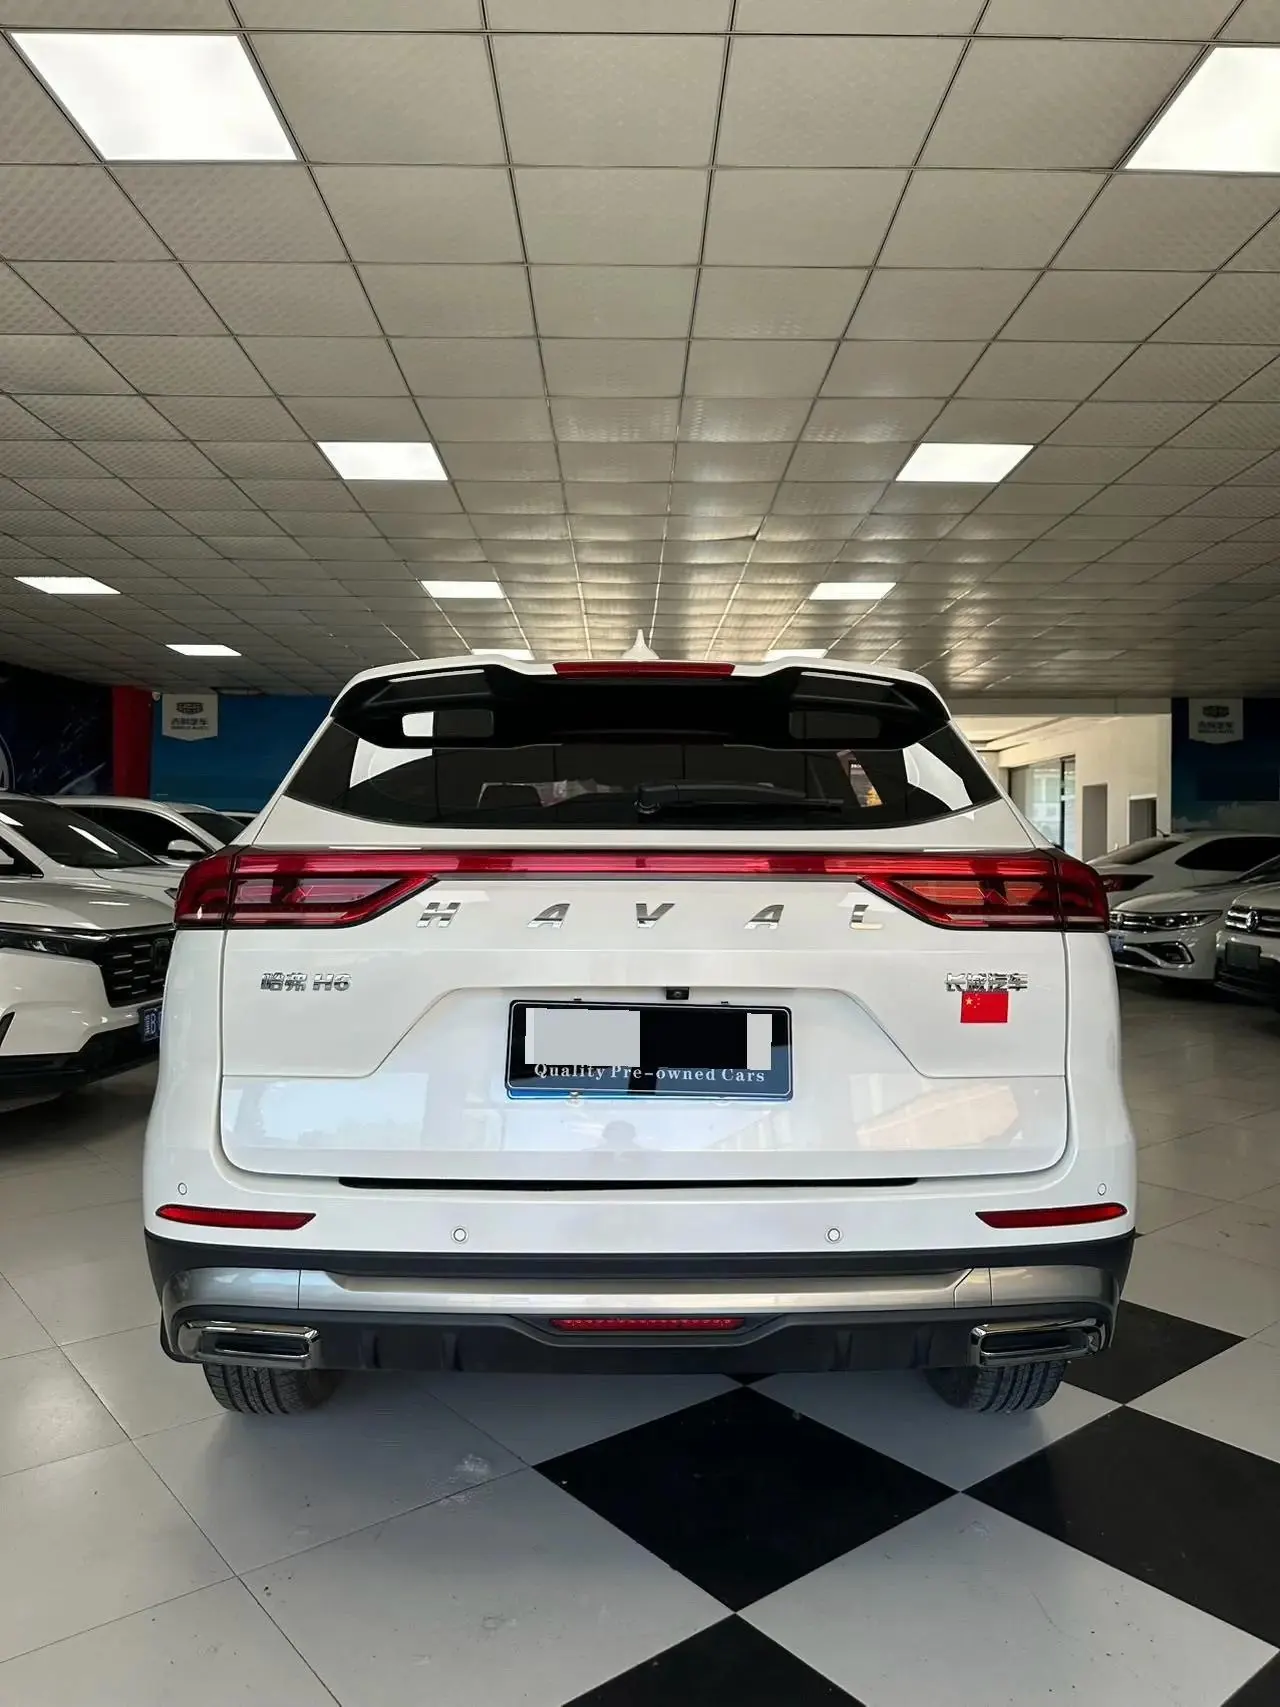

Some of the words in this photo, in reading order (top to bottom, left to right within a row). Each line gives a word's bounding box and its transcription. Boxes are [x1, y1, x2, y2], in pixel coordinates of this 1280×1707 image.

[416, 902, 884, 930] HAVAL
[260, 972, 307, 991] 哈弗
[313, 973, 351, 991] H6
[534, 1063, 605, 1080] Quality
[611, 1066, 716, 1081] Pre-owned
[721, 1067, 765, 1082] Cars
